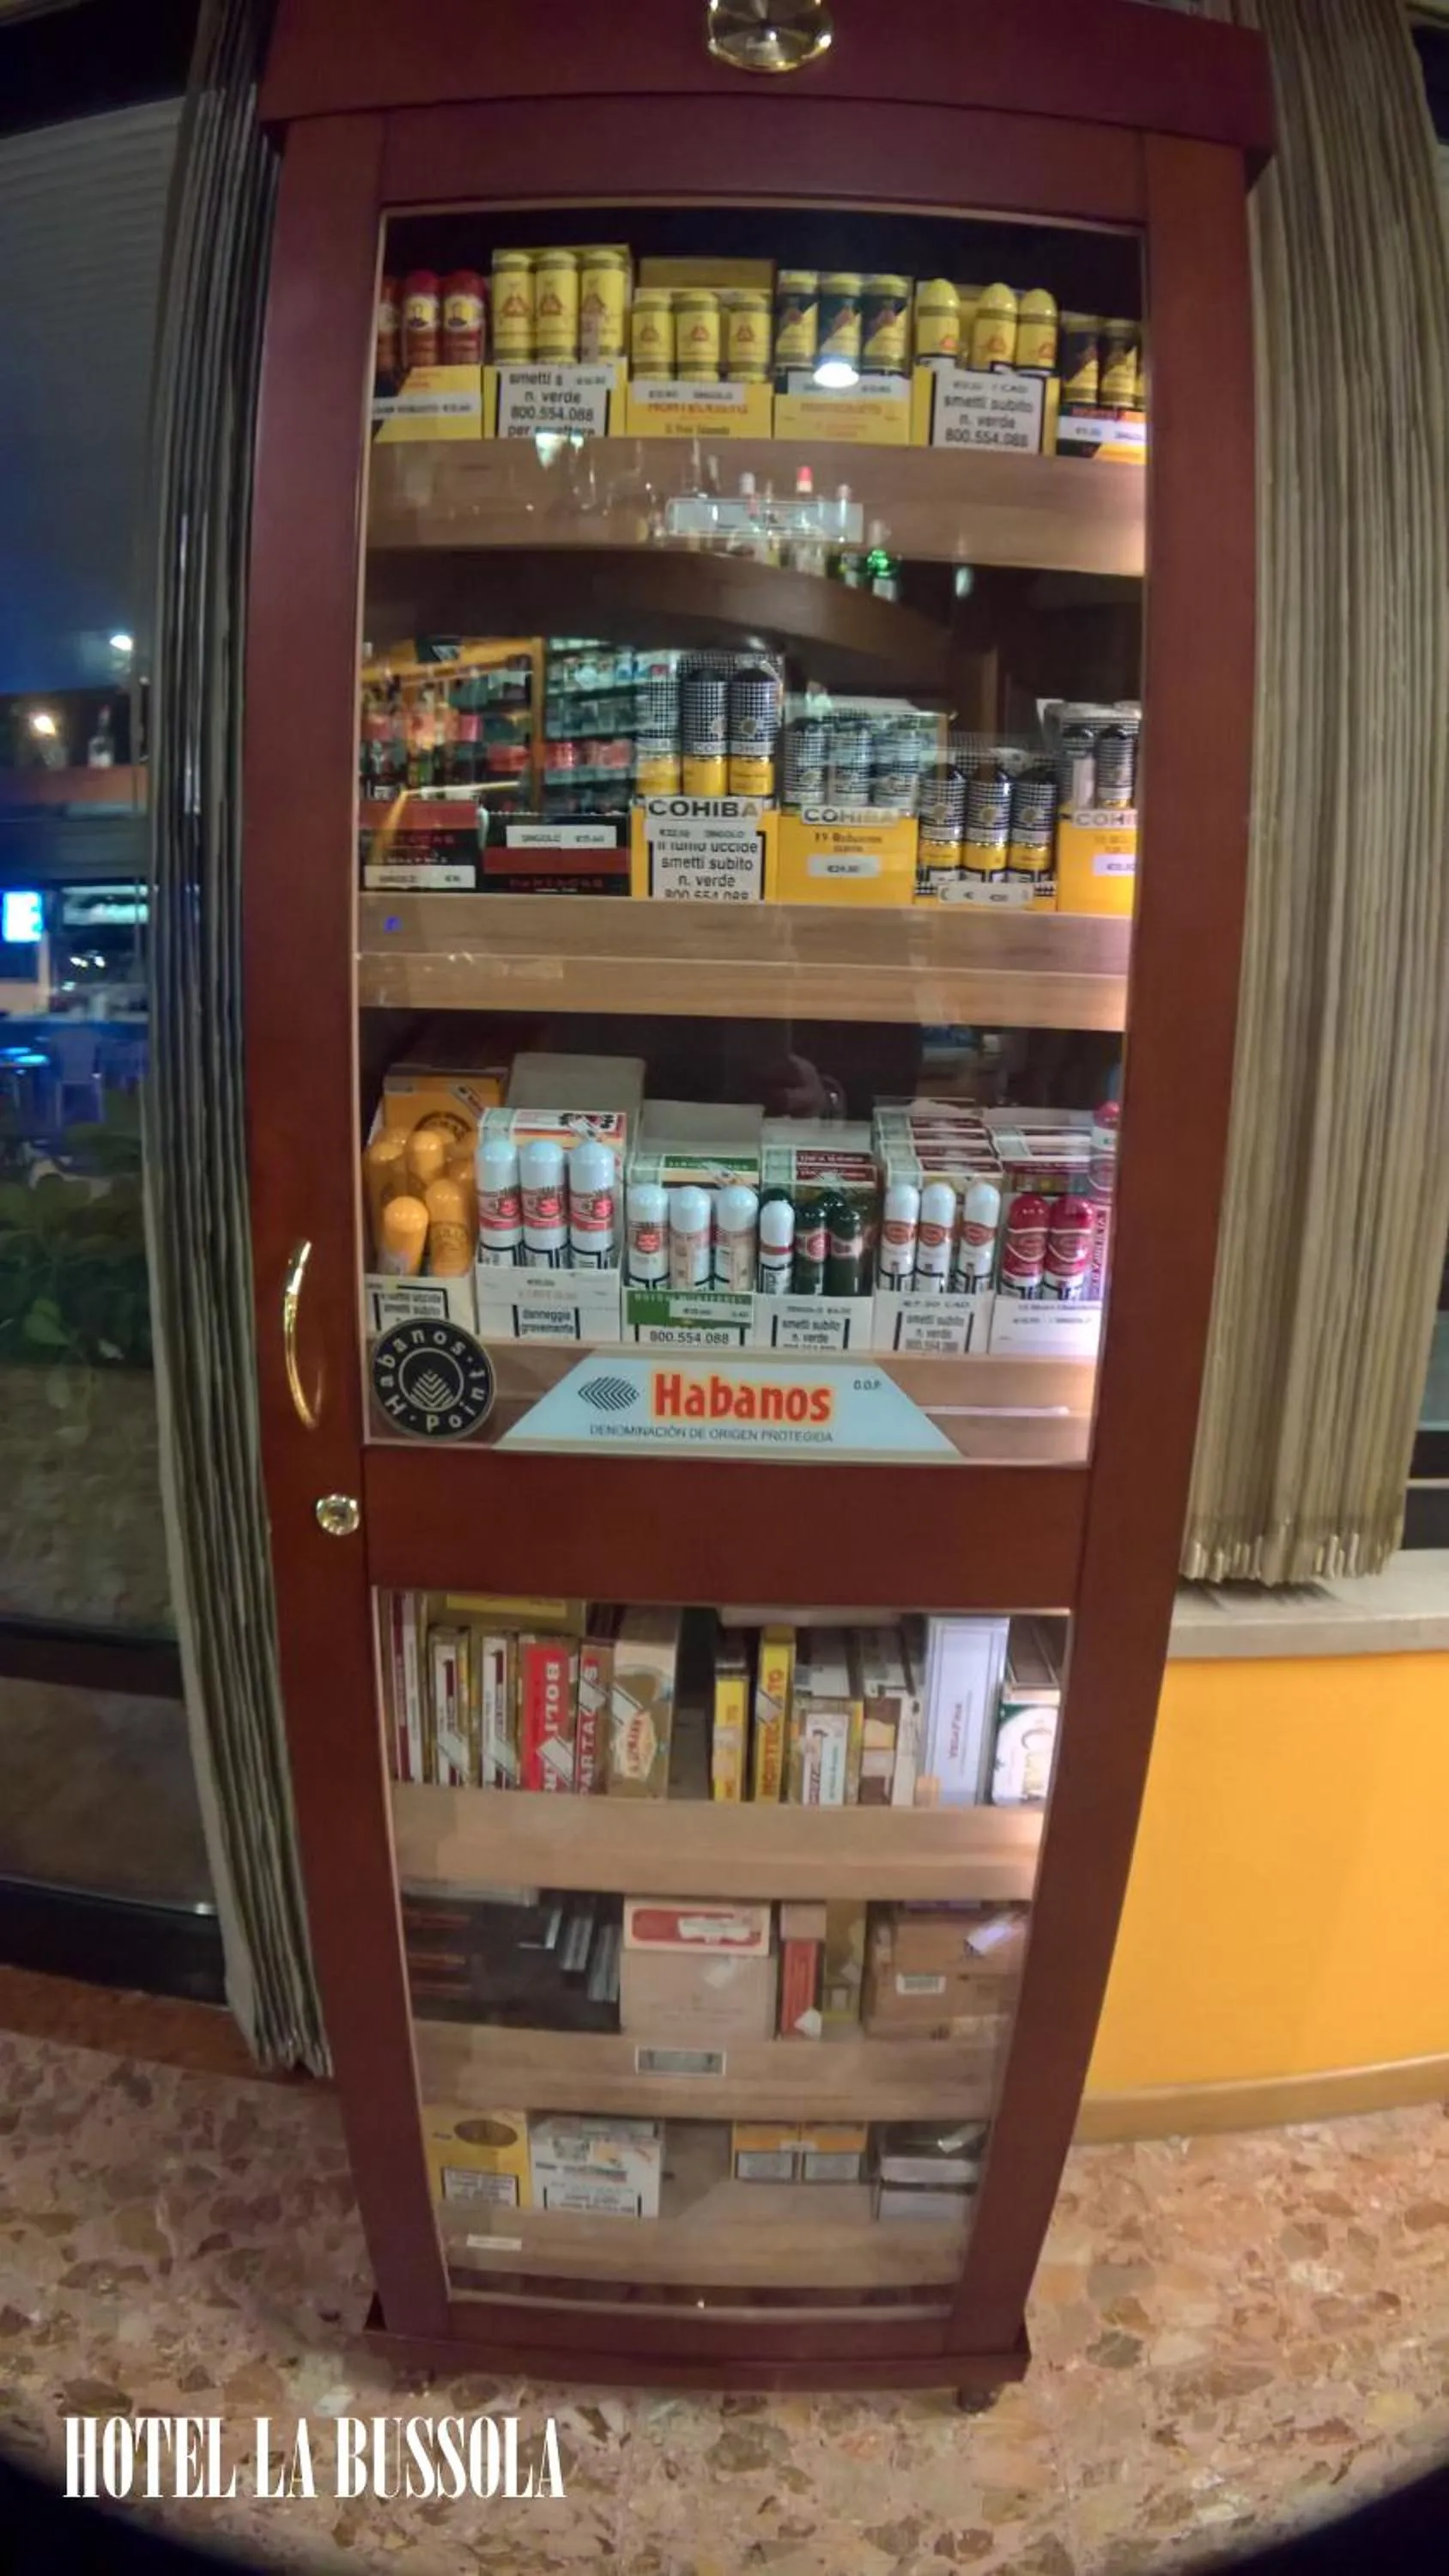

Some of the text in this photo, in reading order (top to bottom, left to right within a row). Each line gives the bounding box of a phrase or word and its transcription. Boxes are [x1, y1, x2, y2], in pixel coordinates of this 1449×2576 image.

[543, 392, 581, 404] verde
[648, 799, 760, 817] COHIBA
[661, 857, 754, 871] smetti subito
[696, 875, 737, 888] verde
[653, 1373, 832, 1423] Habanos
[590, 1423, 834, 1443] DENOMINACIÓN DE ORIGEN PROTEGIDA
